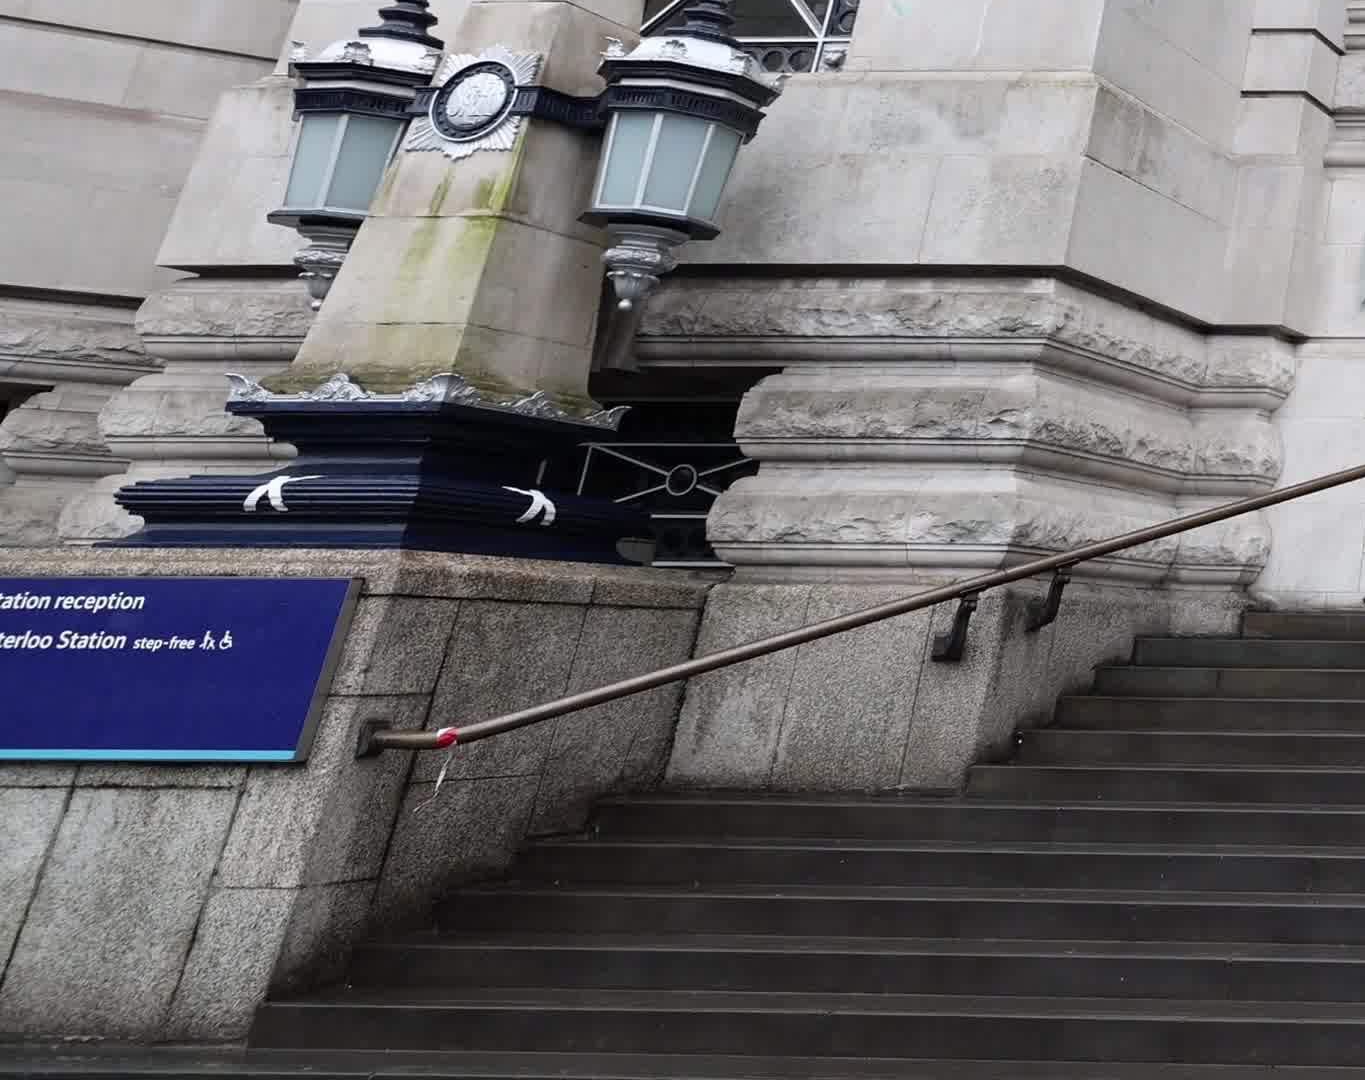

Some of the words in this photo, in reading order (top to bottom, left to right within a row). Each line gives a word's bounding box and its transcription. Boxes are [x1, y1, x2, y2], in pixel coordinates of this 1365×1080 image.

[54, 592, 145, 613] reception
[56, 631, 127, 649] Station
[133, 636, 196, 652] step-free
